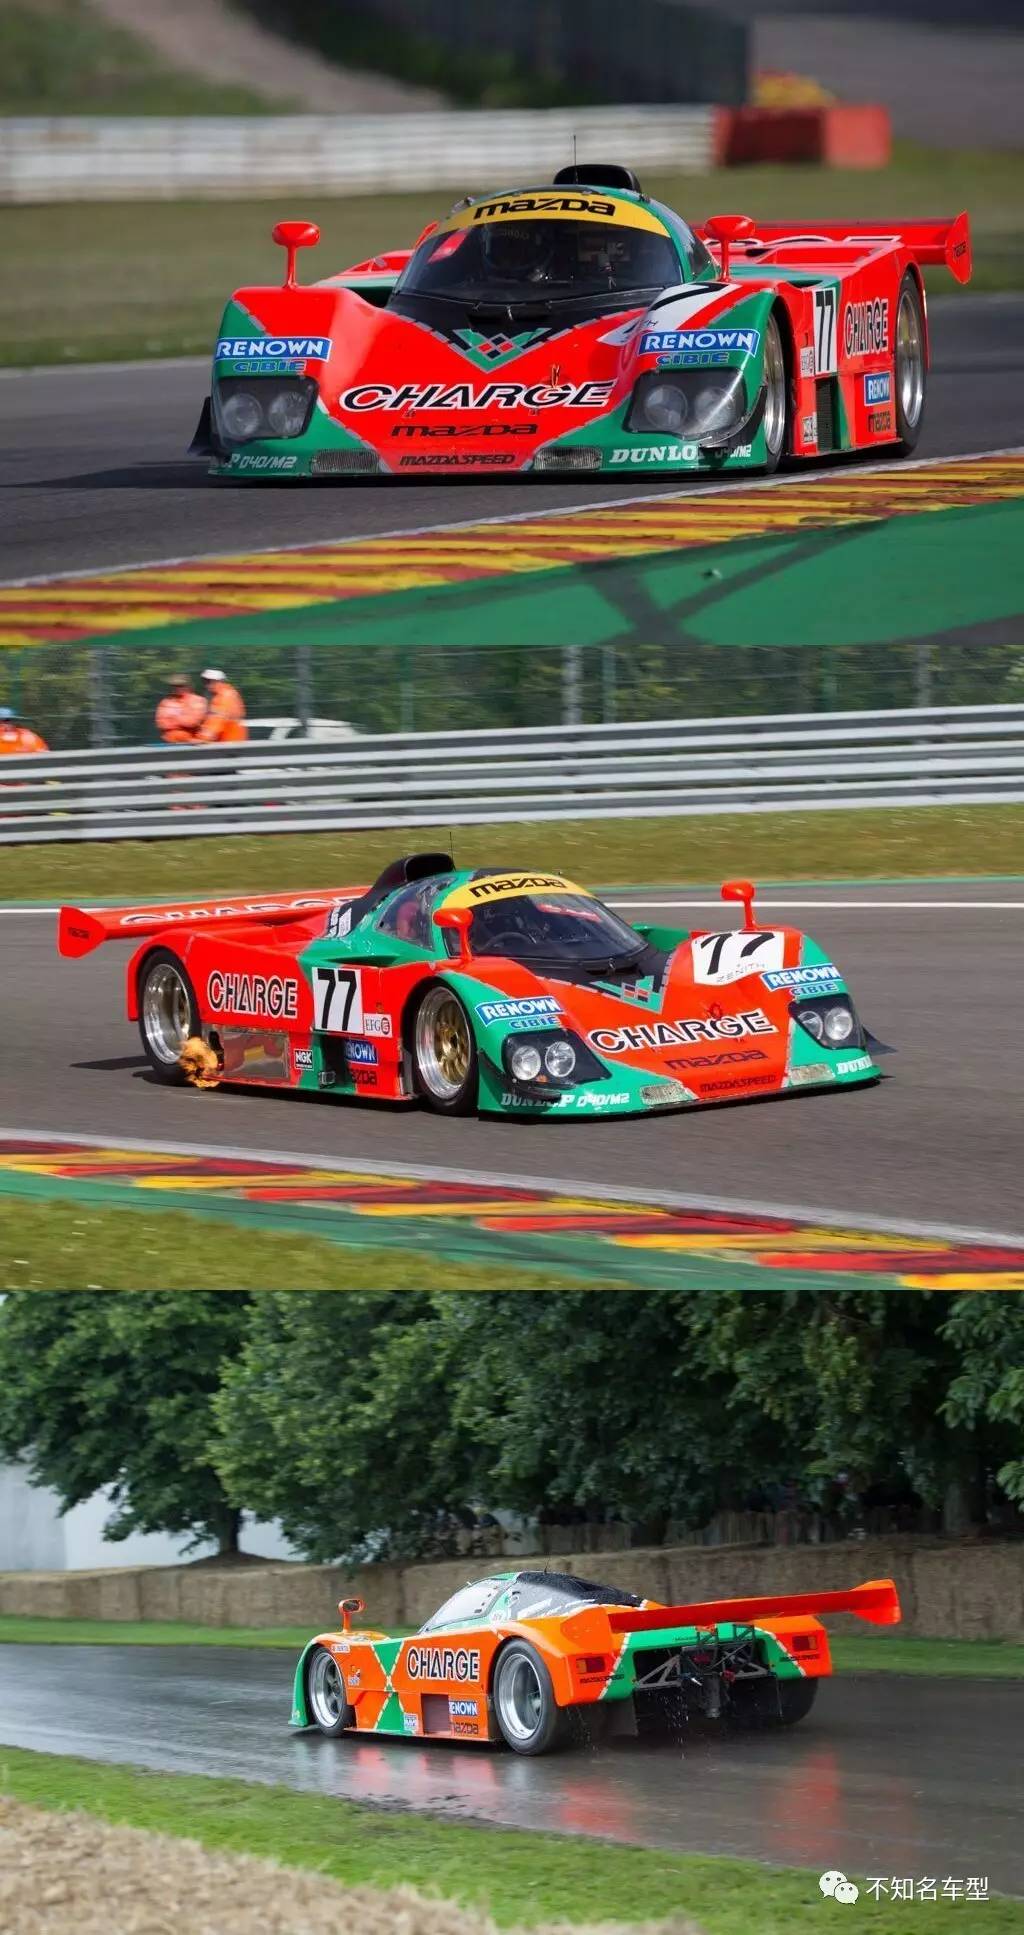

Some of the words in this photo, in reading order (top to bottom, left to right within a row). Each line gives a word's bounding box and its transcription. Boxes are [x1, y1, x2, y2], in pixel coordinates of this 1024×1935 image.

[815, 289, 834, 372] 77
[845, 298, 889, 359] CHARGE
[217, 340, 323, 357] RENOWN
[645, 331, 754, 350] RENOWN
[233, 360, 307, 372] CIBIE
[656, 352, 729, 365] CIBIE
[340, 379, 616, 412] CHARGE
[868, 378, 890, 401] RENOWN
[768, 966, 841, 987] RENOWN
[207, 969, 298, 1020] CHARGE
[318, 968, 357, 1031] 77
[482, 998, 561, 1020] RENOWN
[588, 1008, 779, 1053] CHARGE
[295, 1050, 312, 1063] NGK
[345, 1041, 377, 1060] ENOWN
[407, 1646, 480, 1682] CHARGE
[449, 1701, 478, 1715] ENOWN
